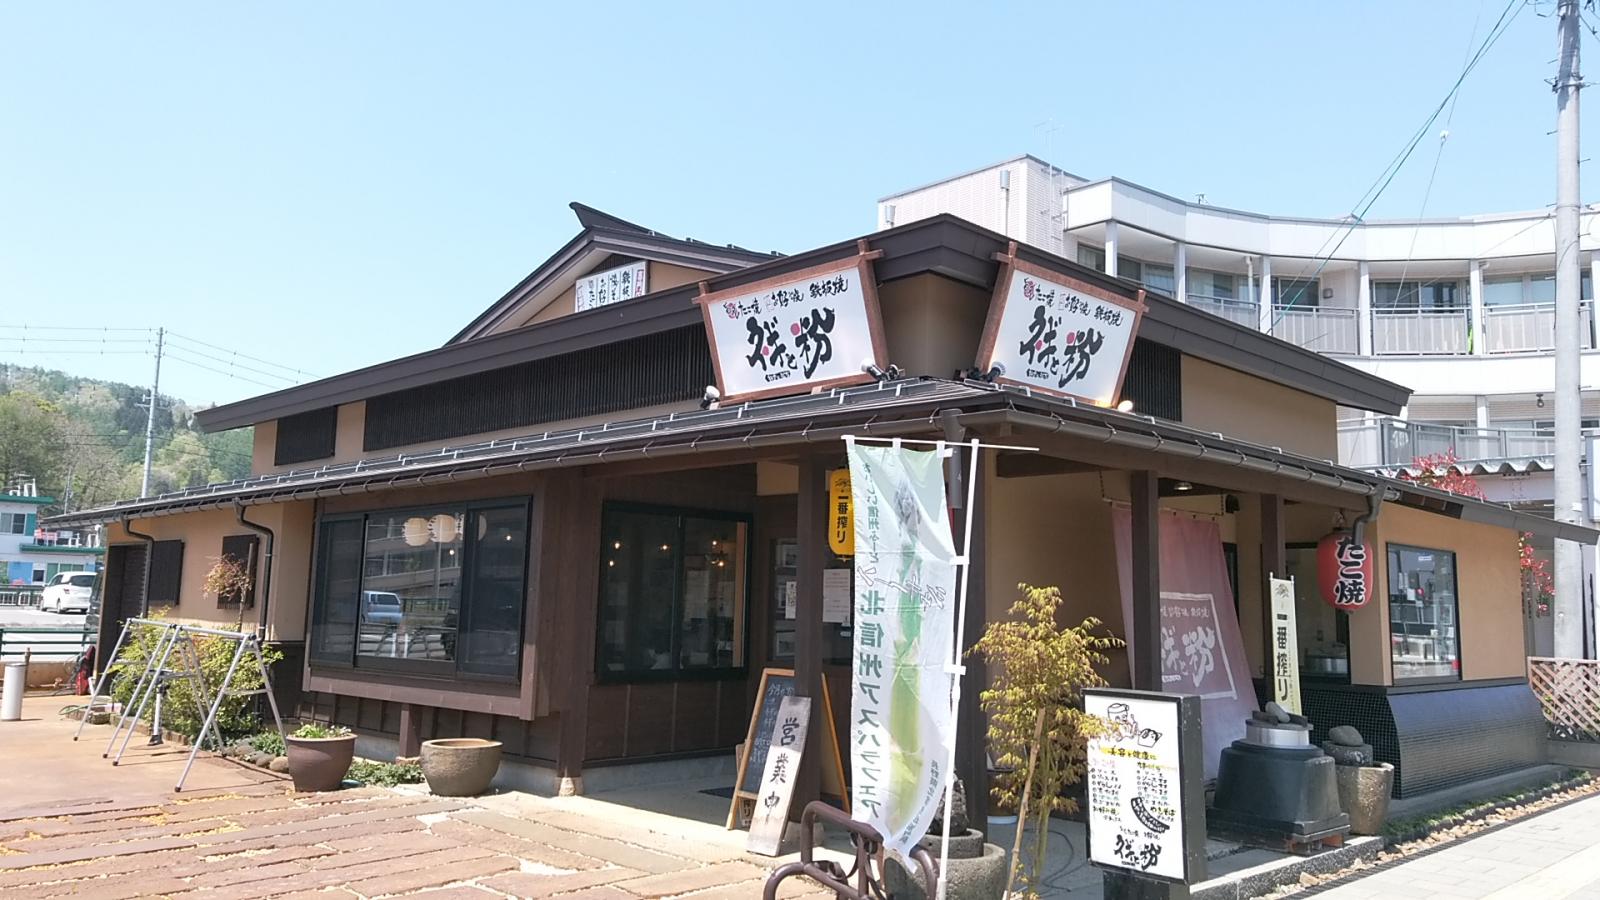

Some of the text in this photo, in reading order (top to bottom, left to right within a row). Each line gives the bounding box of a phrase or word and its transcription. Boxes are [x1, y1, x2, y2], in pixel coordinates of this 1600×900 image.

[809, 274, 848, 299] 鉄板焼
[837, 495, 849, 544] 一番搾り
[1335, 536, 1366, 605] たこ焼
[1276, 613, 1289, 702] 一番搾り
[764, 717, 799, 825] 営業中
